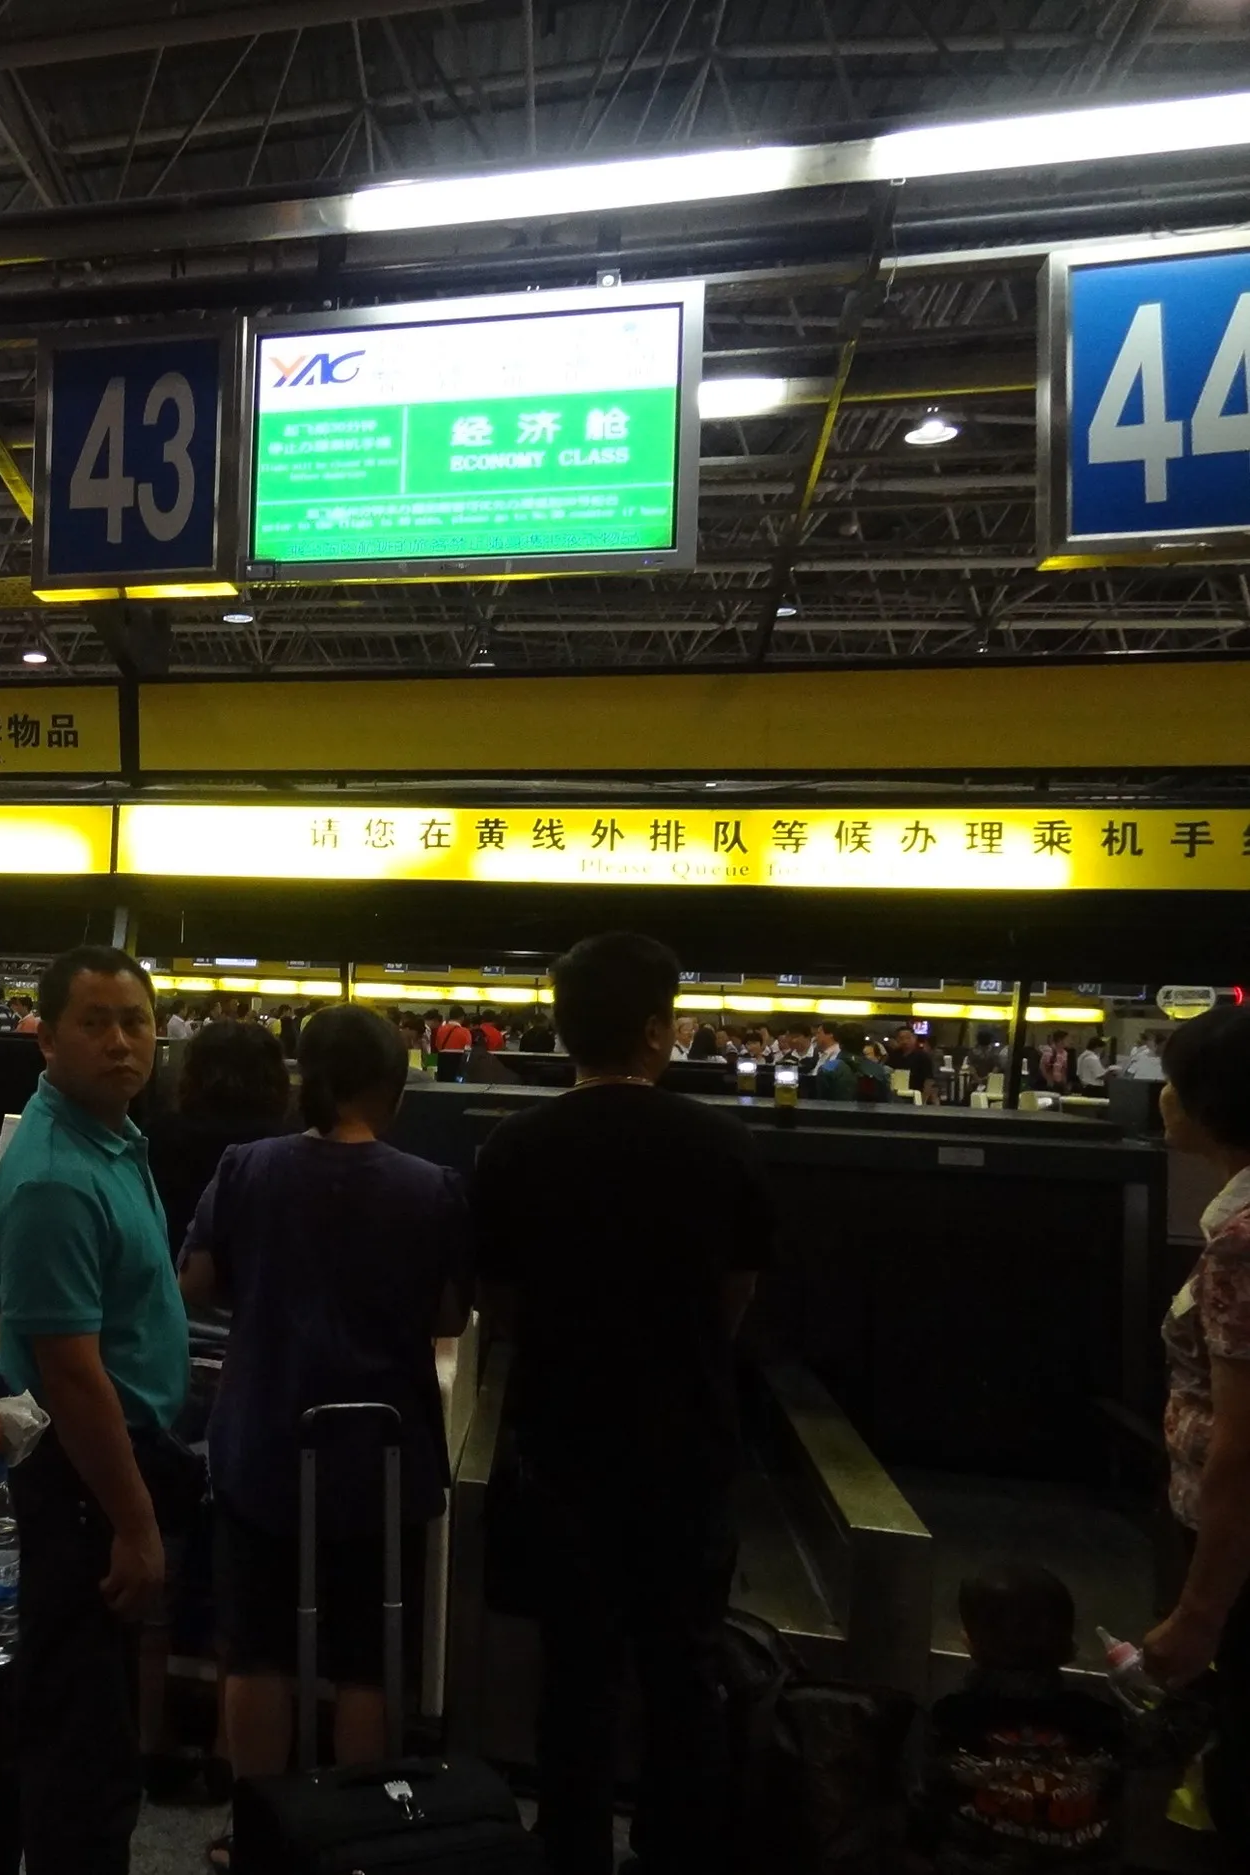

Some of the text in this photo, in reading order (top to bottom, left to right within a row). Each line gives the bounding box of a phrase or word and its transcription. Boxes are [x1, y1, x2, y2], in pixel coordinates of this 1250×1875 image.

[269, 349, 366, 388] YAC
[1088, 291, 1250, 504] 44
[451, 407, 630, 447] 经济舱
[69, 370, 196, 545] 43
[450, 445, 630, 471] ECONOMY CLASS
[310, 818, 1250, 858] 请您在黄线外排队等候办理乘机手
[671, 860, 750, 879] Queue
